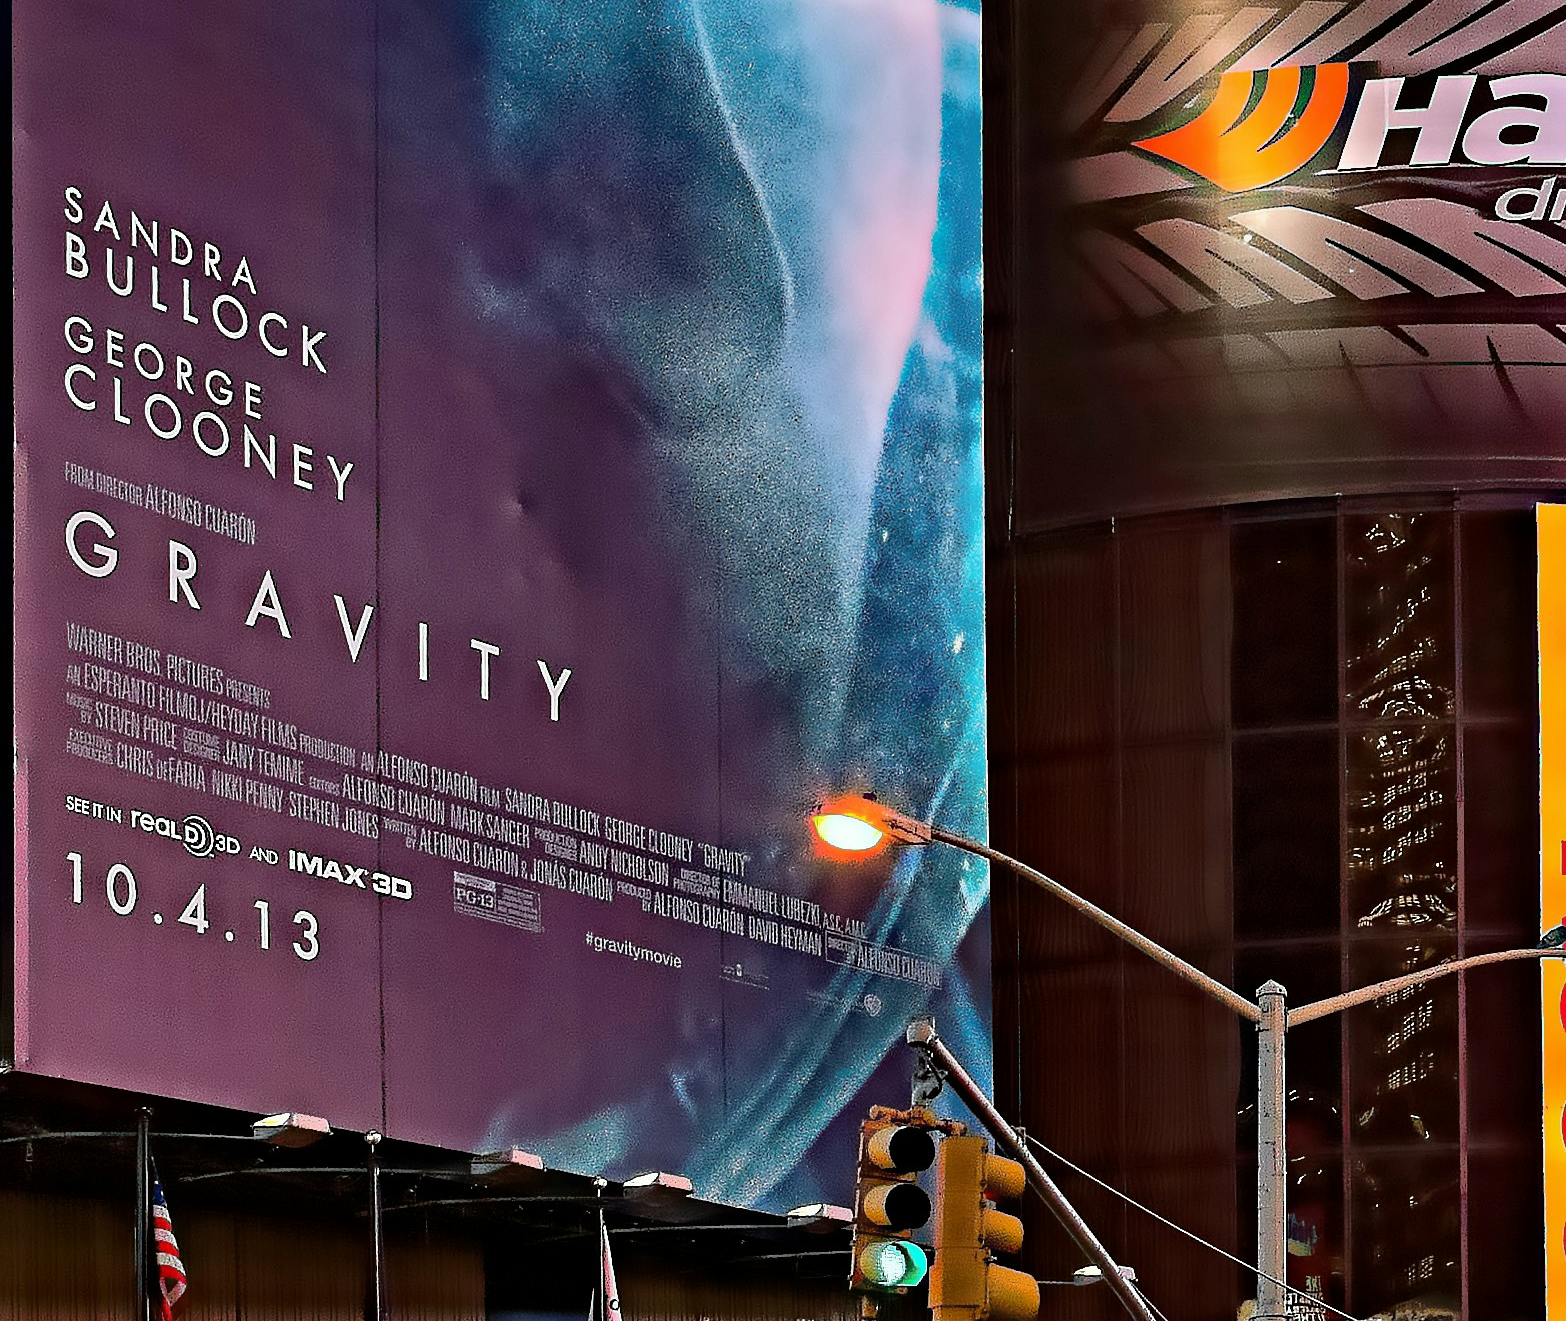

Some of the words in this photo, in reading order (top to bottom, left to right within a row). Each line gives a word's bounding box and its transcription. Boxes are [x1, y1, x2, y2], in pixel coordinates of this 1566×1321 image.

[64, 186, 257, 294] SANDRA
[65, 231, 328, 373] BULLOCK
[64, 316, 263, 419] GEORGE
[64, 363, 354, 502] CLOONEY
[96, 472, 143, 506] DIRECTOR
[146, 484, 201, 527] ALFONSO
[65, 510, 572, 722] GRAVITY
[66, 620, 124, 664] WARNER
[167, 653, 224, 696] PICTURES
[226, 678, 271, 709] PRESENTS
[84, 662, 156, 708] ESPERANTO
[261, 715, 298, 751] FILMS
[299, 732, 355, 768] PRODUCTION
[377, 749, 428, 787] ALFONSO
[505, 787, 550, 822] SANDRA
[553, 801, 601, 838] BULLOCK
[605, 815, 646, 851] GEORGE
[648, 828, 693, 863] CLOONEY
[96, 701, 140, 739] STEVEN
[143, 715, 177, 750] PRICE
[223, 739, 255, 772] JANY
[257, 748, 304, 786] TEMIME
[343, 774, 394, 812] ALFONSO
[450, 803, 485, 837] MARK
[485, 815, 530, 849] SANGER
[580, 840, 611, 869] ANDY
[611, 848, 669, 888] NICHOLSON
[723, 878, 782, 917] EMMANUEL
[66, 794, 90, 816] SEE
[92, 801, 105, 819] IT
[105, 804, 122, 824] IN
[215, 833, 241, 855] 3D
[249, 844, 279, 865] AND
[287, 849, 368, 889] IMAX
[371, 871, 414, 901] 3D
[117, 741, 153, 777] CHRIS
[212, 769, 244, 805] NIKKI
[246, 781, 284, 814] PENNY
[289, 791, 339, 829] STEPHEN
[342, 805, 379, 839] JONES
[420, 827, 470, 864] ALFONSO
[653, 891, 700, 924] ALFONSO
[748, 914, 779, 944] DAVID
[780, 924, 822, 957] HEYMAN
[66, 851, 321, 962] 10.4.13
[585, 930, 683, 969] #gravitymovie
